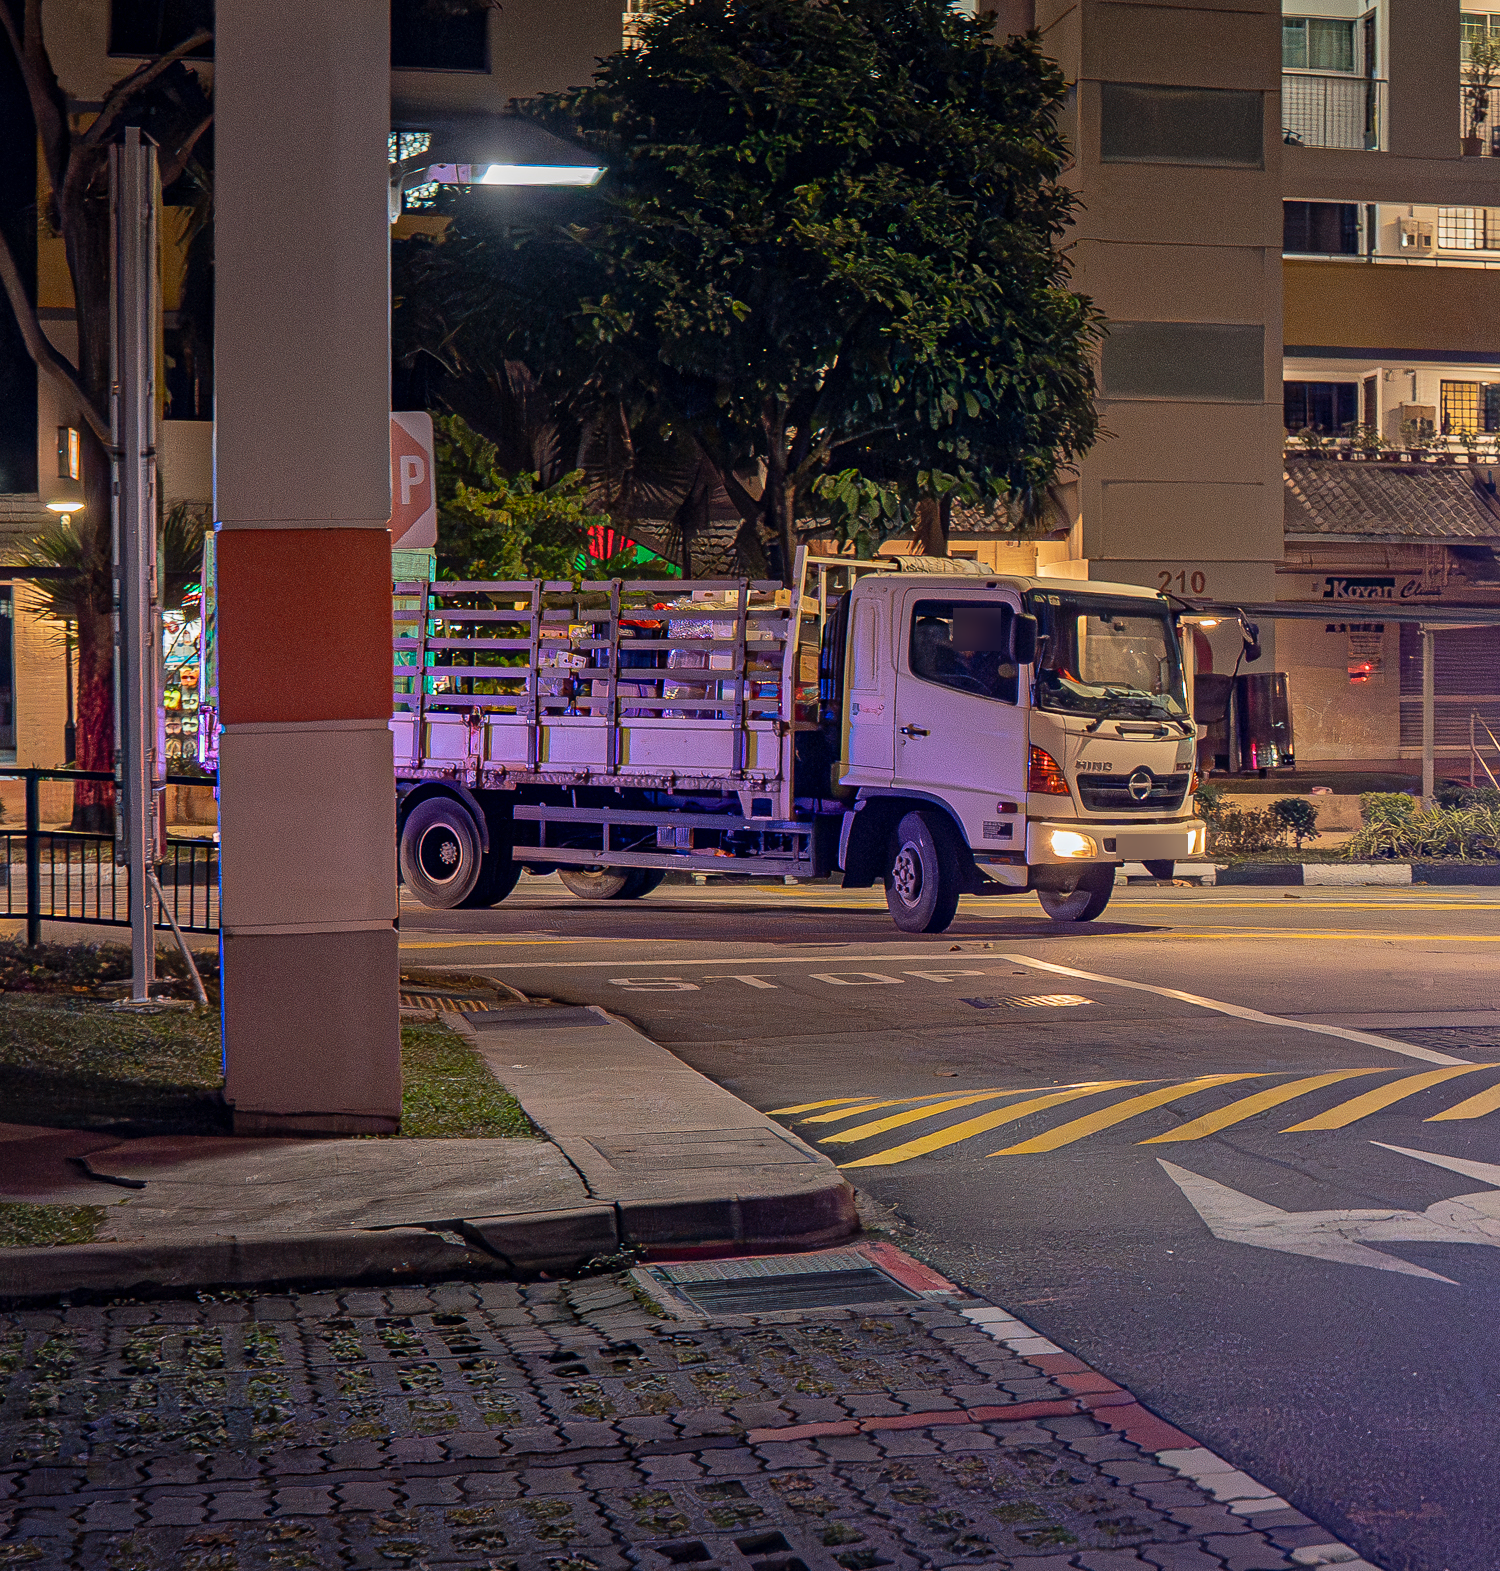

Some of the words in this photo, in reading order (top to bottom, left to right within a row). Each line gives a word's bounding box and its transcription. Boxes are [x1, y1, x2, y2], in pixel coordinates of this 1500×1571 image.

[1158, 570, 1206, 594] 210
[1332, 580, 1393, 598] Kovan
[607, 969, 986, 992] STOP
